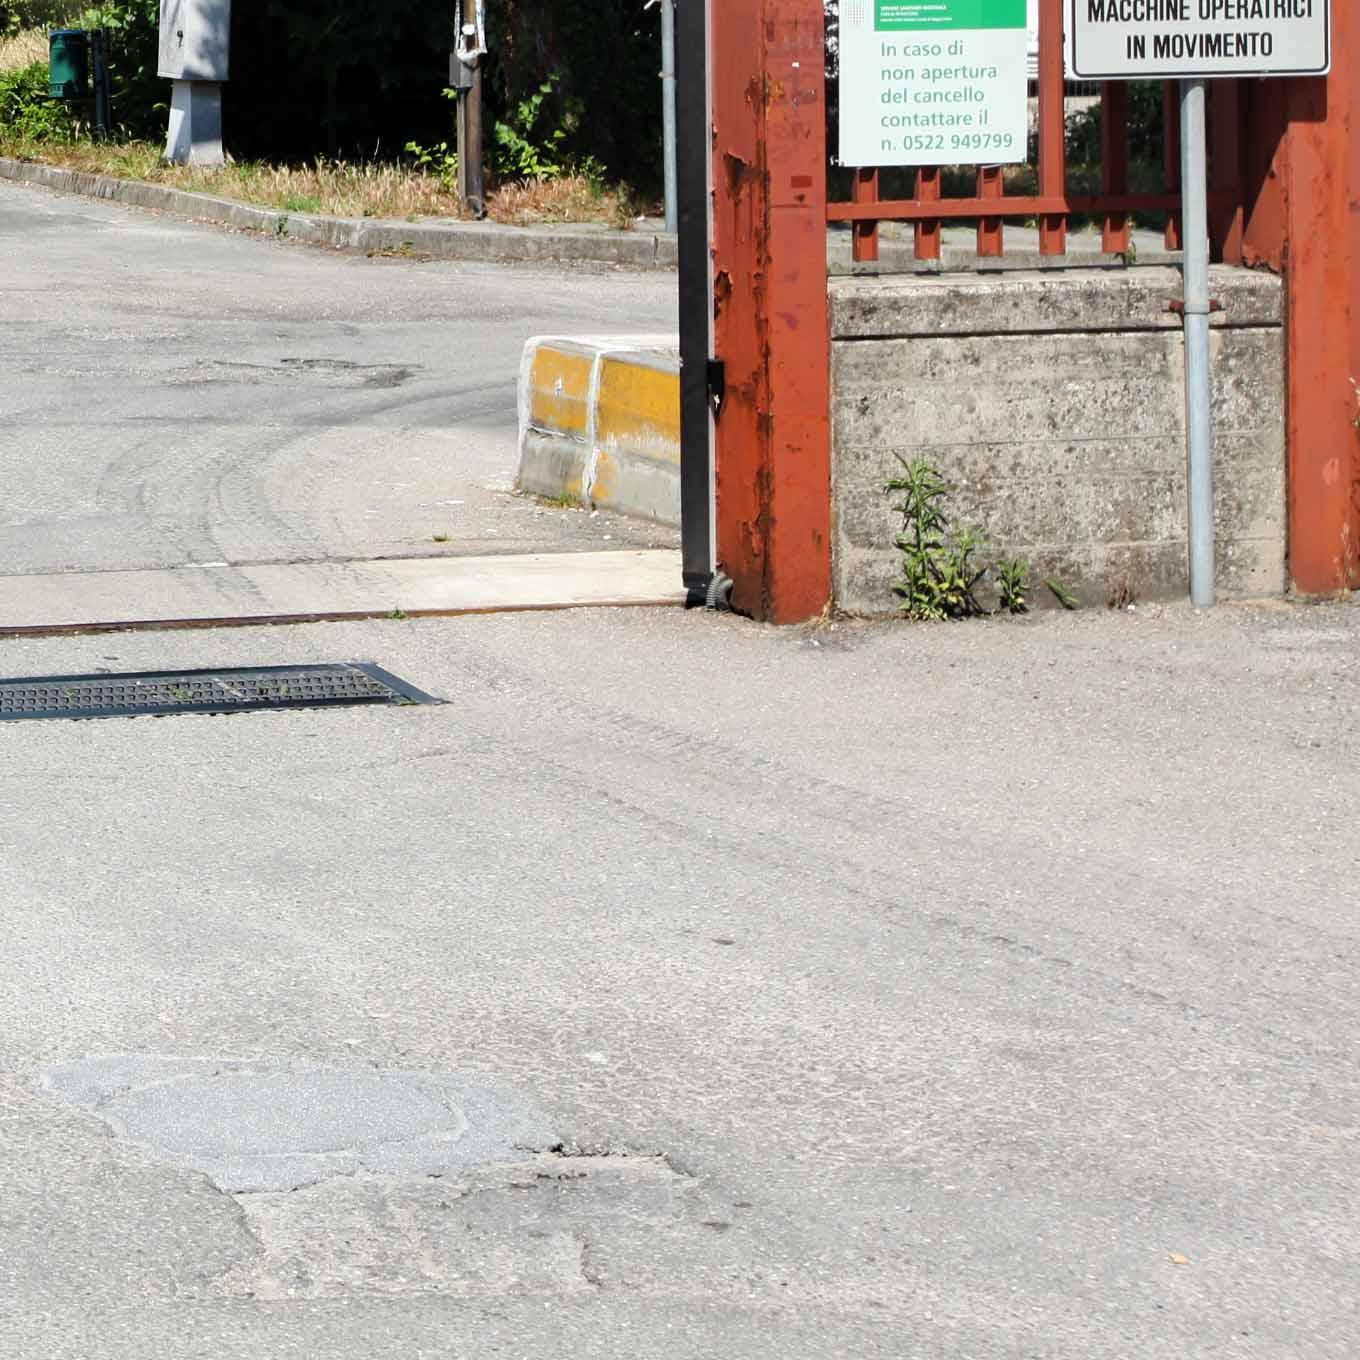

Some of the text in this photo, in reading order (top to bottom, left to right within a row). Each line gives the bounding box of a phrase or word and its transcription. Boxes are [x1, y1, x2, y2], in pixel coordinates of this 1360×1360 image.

[881, 40, 964, 57] In caso di
[1126, 32, 1273, 59] IN MOVIMENTO
[881, 65, 998, 84] non apertura
[881, 87, 985, 104] del cancello
[881, 108, 989, 127] contattare il
[881, 133, 1013, 151] n. 0522 949799
